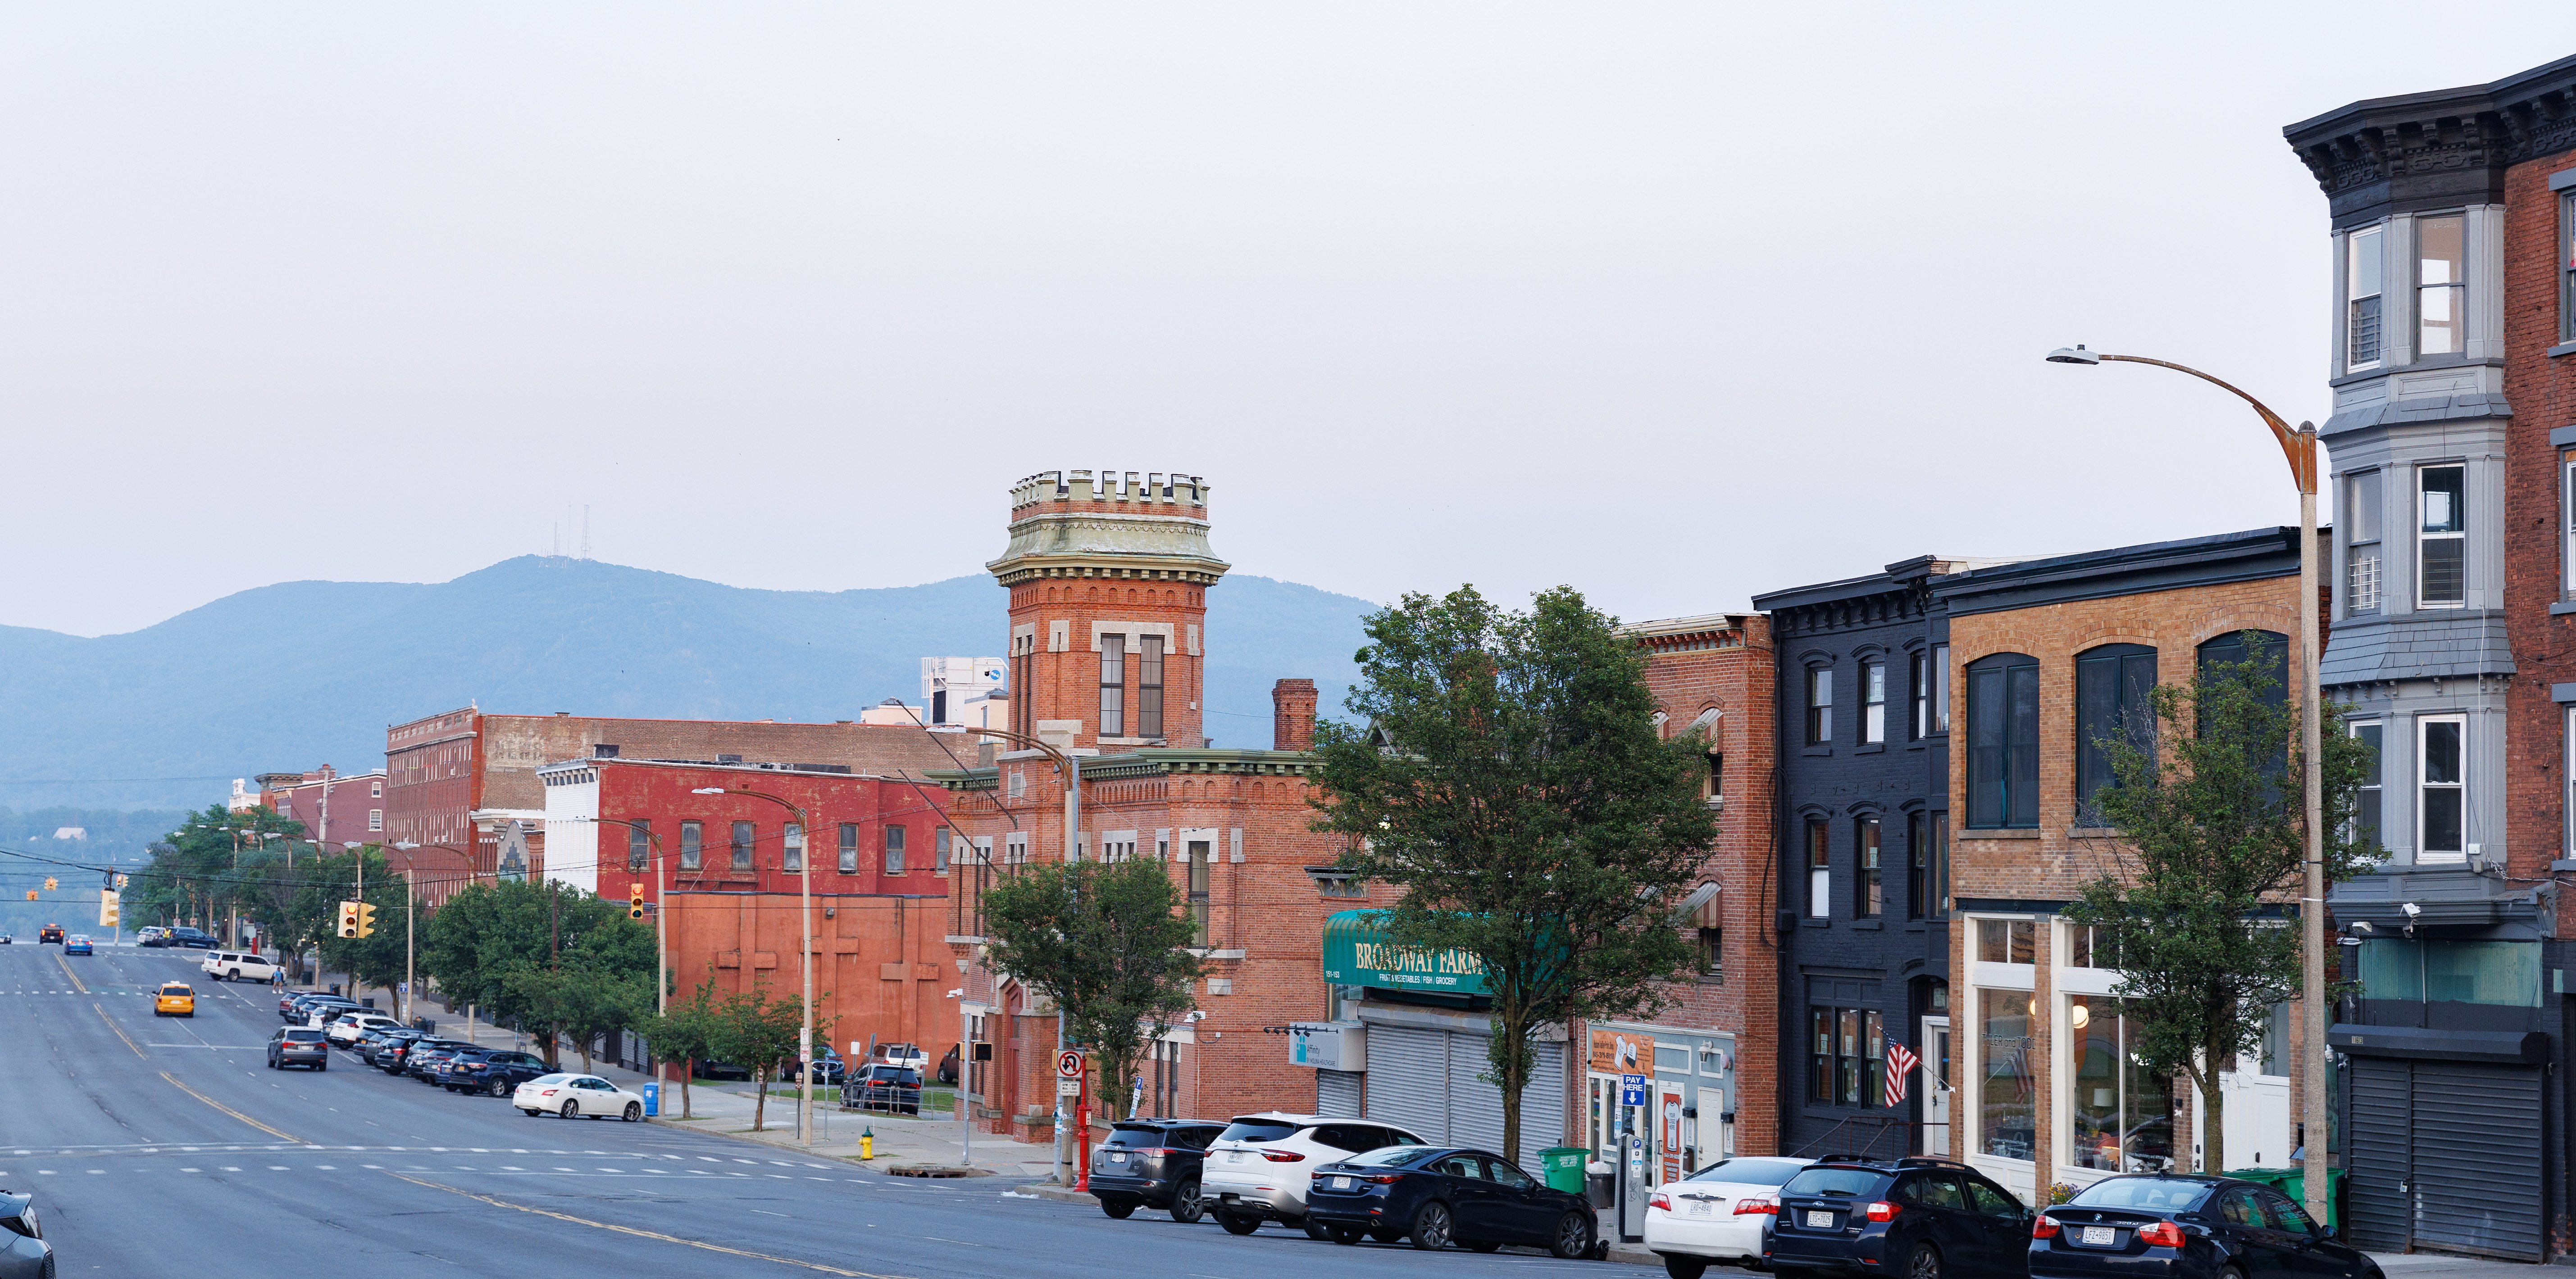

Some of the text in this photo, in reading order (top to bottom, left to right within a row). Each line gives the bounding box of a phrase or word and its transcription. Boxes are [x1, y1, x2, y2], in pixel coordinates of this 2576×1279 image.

[1356, 943, 1434, 972] BROADWAY
[1395, 975, 1420, 984] VEGETABLES
[1423, 976, 1433, 984] FISH
[1436, 977, 1457, 985] GROCERY
[1981, 1033, 2003, 1047] TYLER
[2004, 1036, 2016, 1048] and
[1306, 1044, 1320, 1057] Affinity
[1320, 1059, 1336, 1067] HEALTHCARE
[1623, 1084, 1643, 1092] HERE
[2099, 1232, 2111, 1240] 9851
